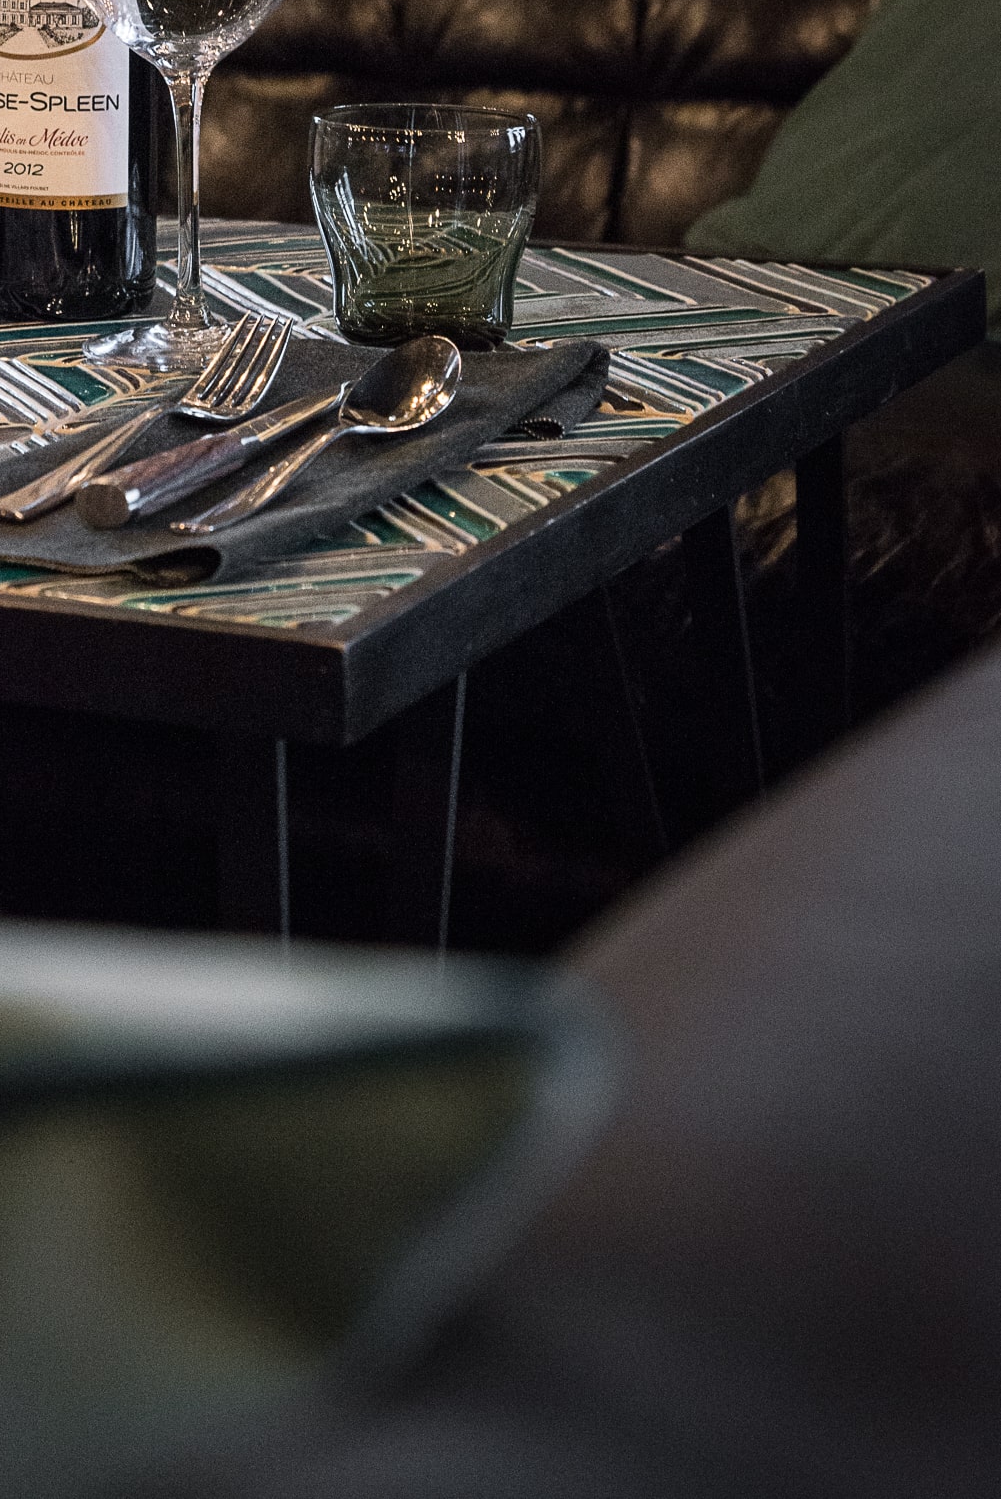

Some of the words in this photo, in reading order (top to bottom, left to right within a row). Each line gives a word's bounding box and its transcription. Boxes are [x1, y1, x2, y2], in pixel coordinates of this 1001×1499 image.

[15, 137, 27, 146] en
[28, 127, 89, 150] Médoc
[3, 161, 44, 177] 2012
[40, 198, 54, 207] AU
[61, 197, 112, 207] CHÂTEAU
